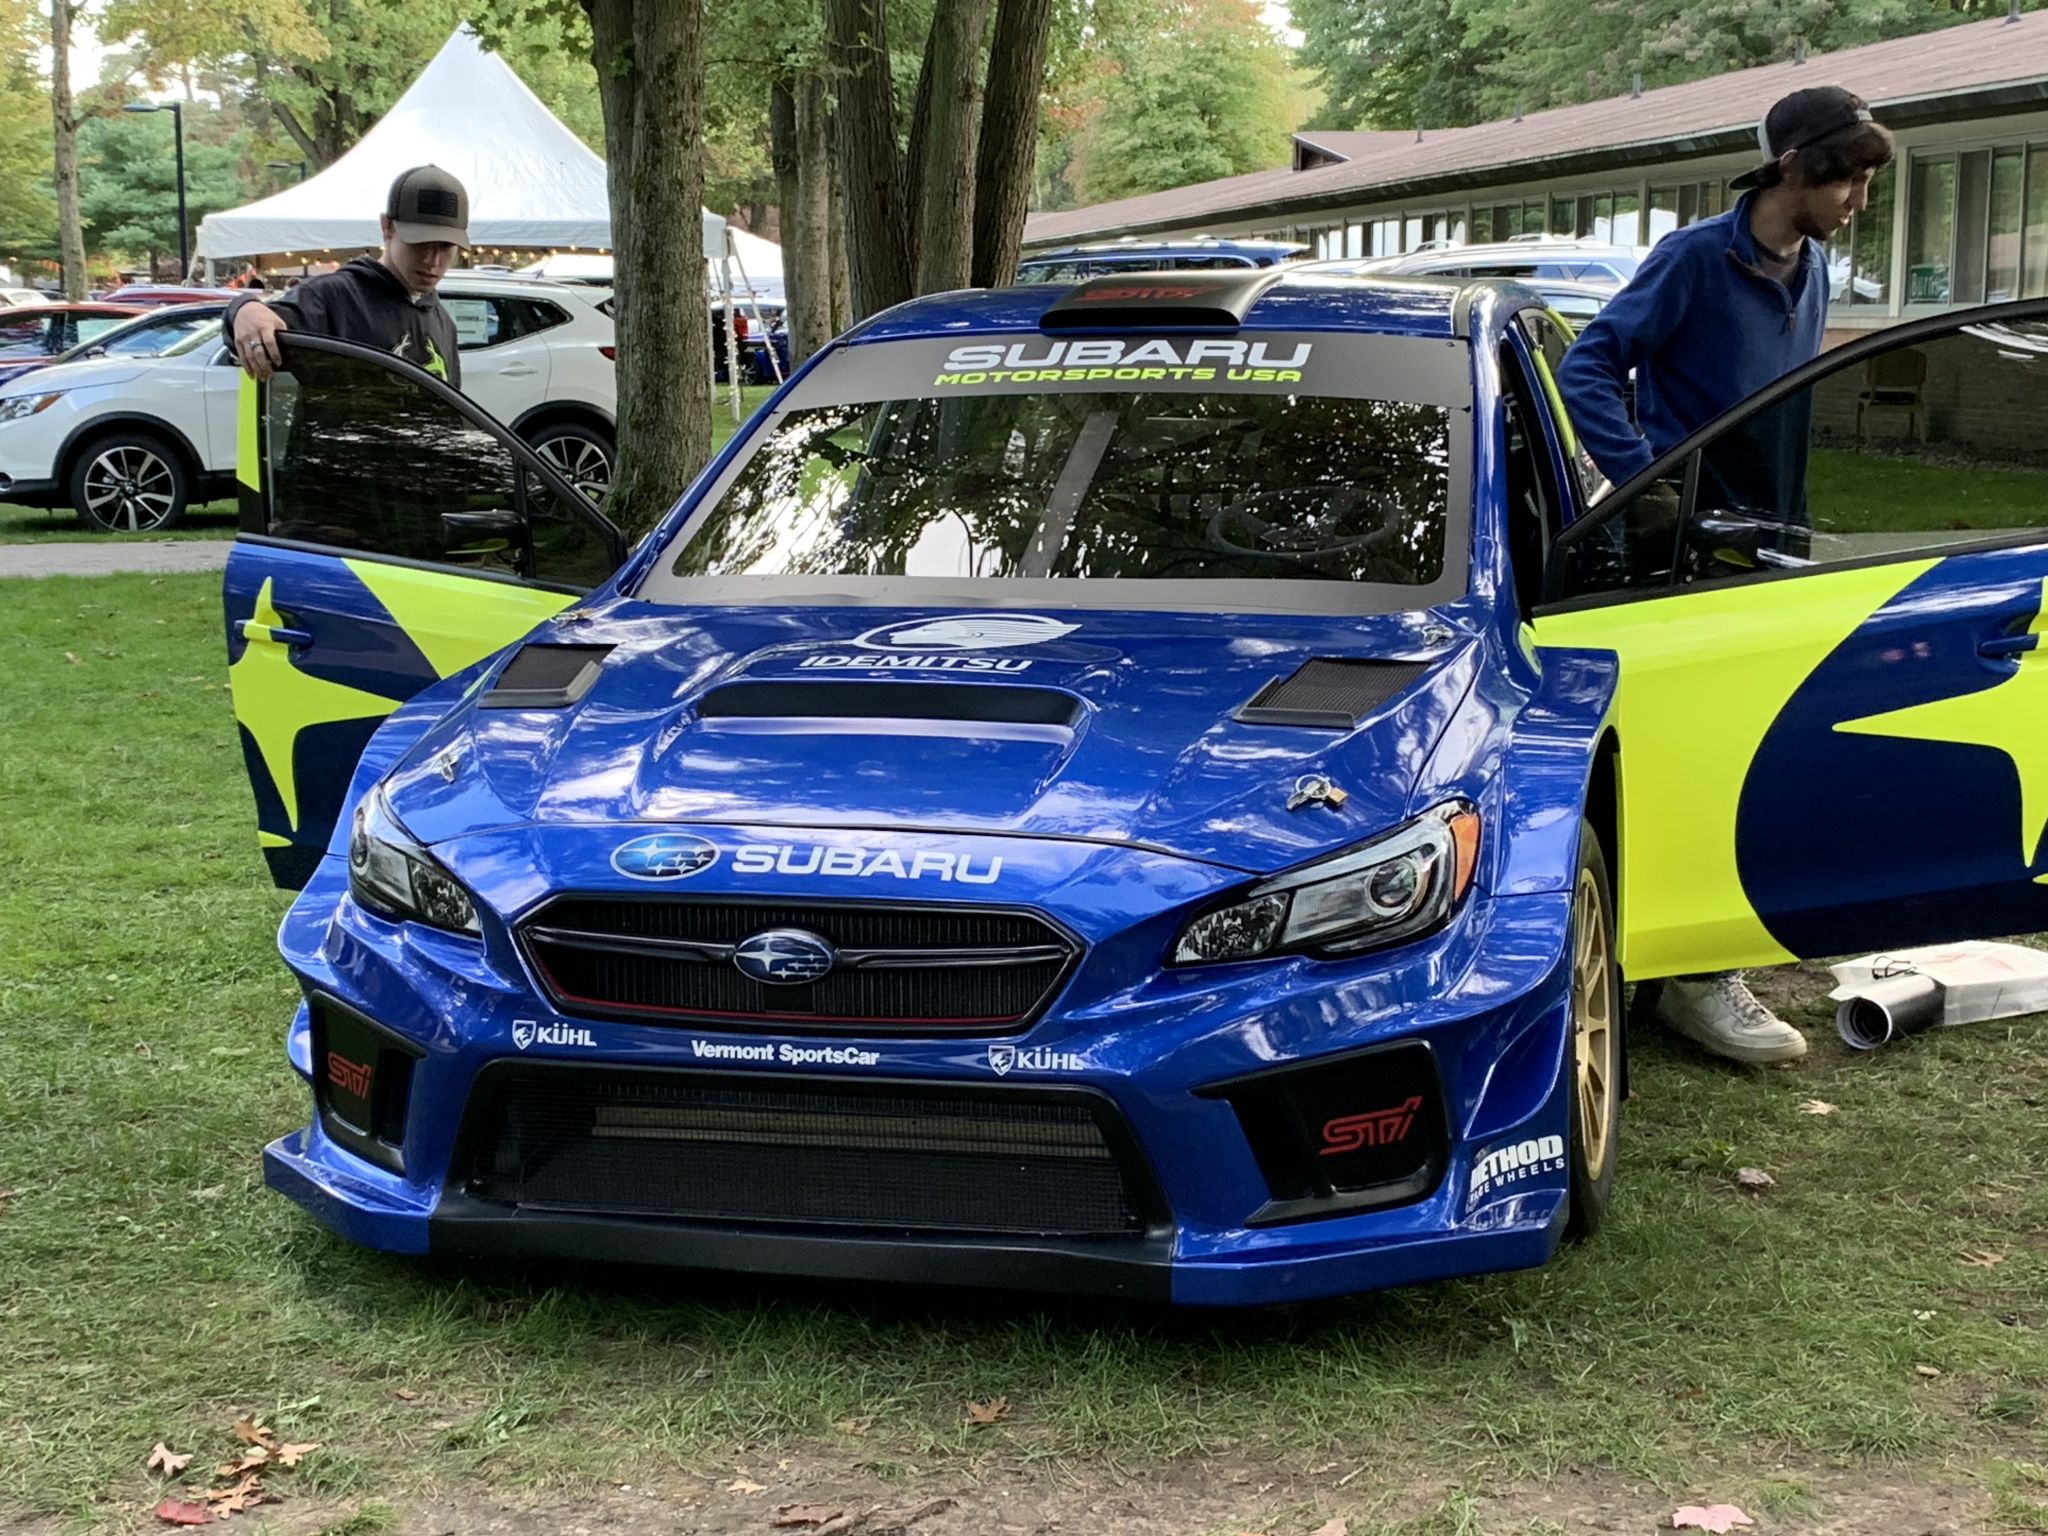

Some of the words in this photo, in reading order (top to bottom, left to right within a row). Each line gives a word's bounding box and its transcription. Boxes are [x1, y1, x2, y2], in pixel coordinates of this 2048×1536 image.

[944, 339, 1312, 371] SUBARU
[934, 367, 1216, 386] MOTORSPORTS
[1226, 368, 1303, 383] USA
[799, 655, 1033, 672] IDEMITSU
[731, 844, 1003, 885] SUBARU
[537, 1022, 597, 1047] KÜHL
[691, 1039, 774, 1061] Vermont
[778, 1043, 880, 1066] SportsCar
[1017, 1047, 1084, 1070] KÜHL
[1494, 1157, 1565, 1187] WHEELS
